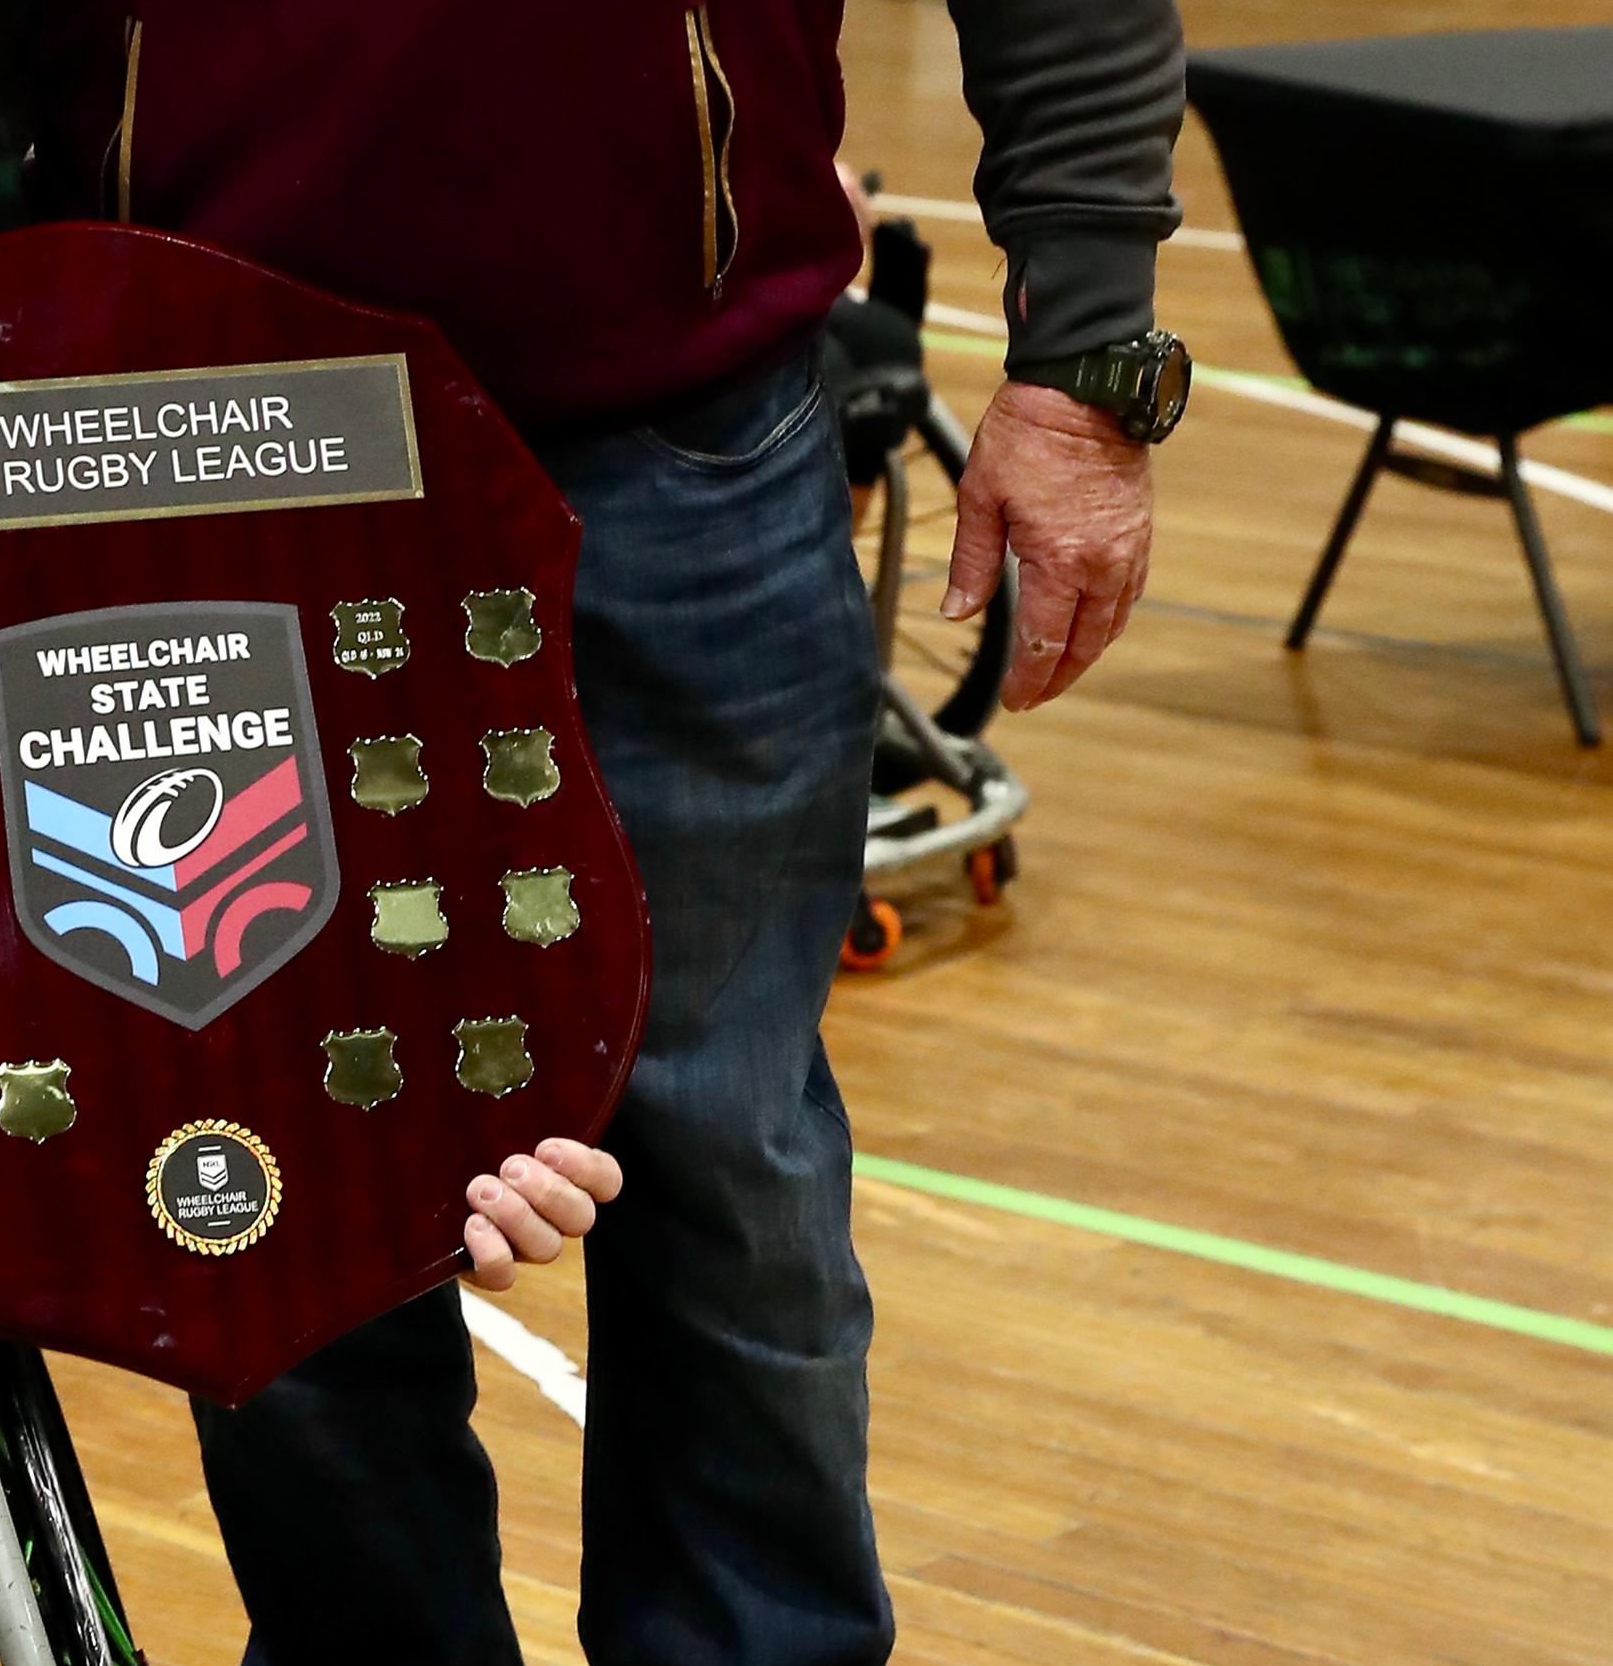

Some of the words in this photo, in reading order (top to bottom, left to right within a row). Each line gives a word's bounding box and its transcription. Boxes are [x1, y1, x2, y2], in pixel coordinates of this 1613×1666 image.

[3, 452, 157, 495] RUGBY
[170, 437, 349, 484] LEAGUE
[355, 611, 382, 623] 2022
[36, 633, 251, 677] WHEELCHAIR
[90, 676, 209, 713] STATE
[19, 709, 293, 769] CHALLENGE
[176, 1191, 247, 1208] WHEELCHAIR
[178, 1205, 214, 1219] RUGBY
[217, 1201, 259, 1215] LEAGUE
